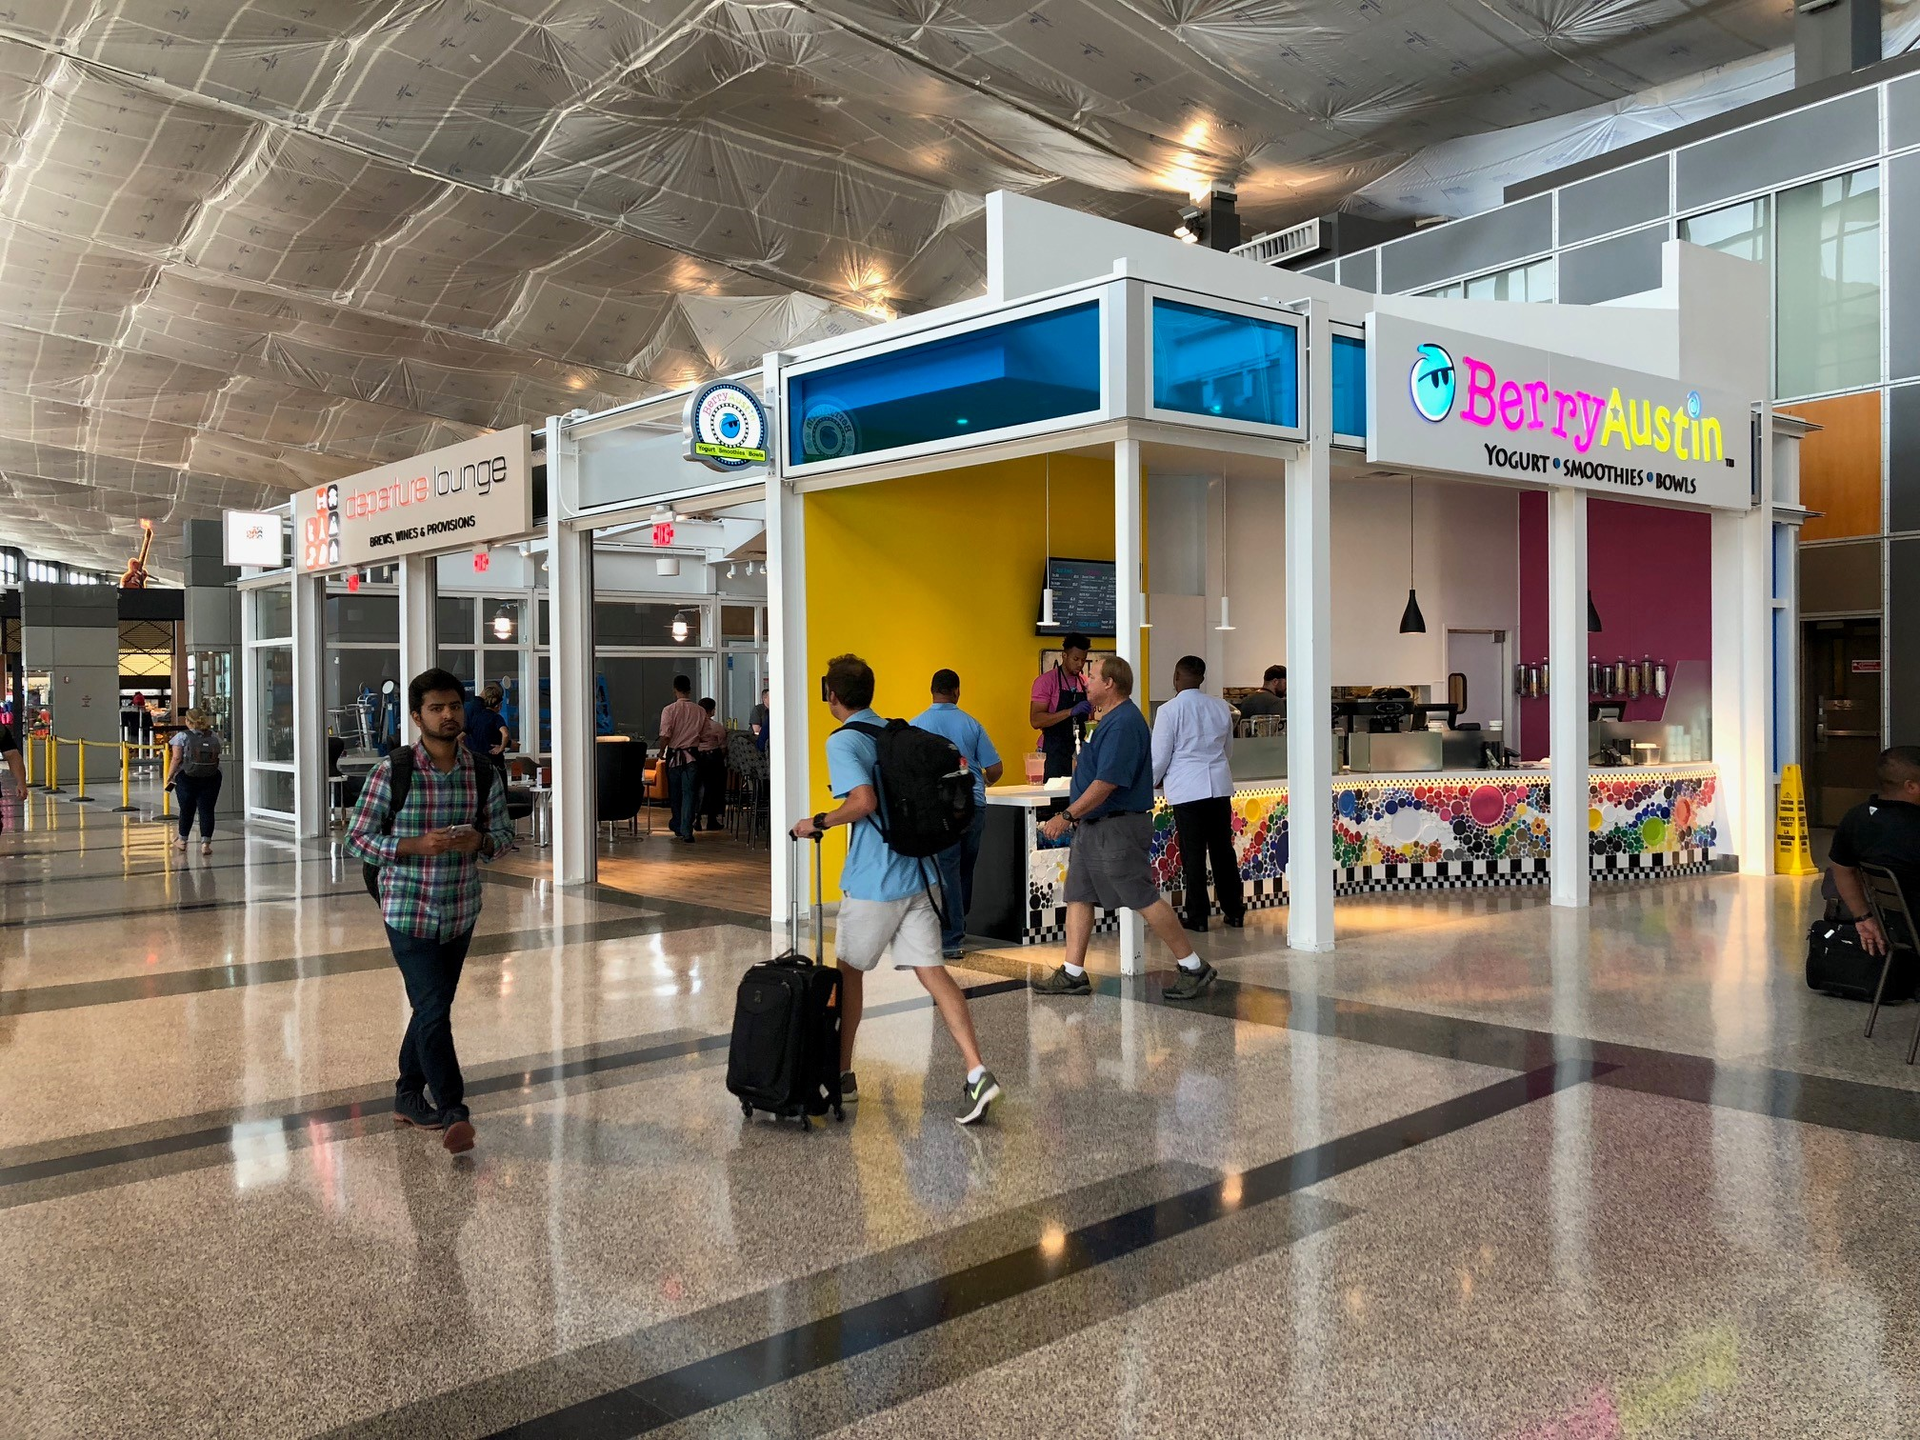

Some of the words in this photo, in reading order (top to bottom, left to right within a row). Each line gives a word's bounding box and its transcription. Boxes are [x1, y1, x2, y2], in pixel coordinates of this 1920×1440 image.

[1460, 356, 1723, 462] BerryAustin
[697, 444, 716, 453] Yogurt
[718, 447, 745, 456] Smoothies
[748, 450, 764, 458] Bowls
[1484, 443, 1550, 473] YOGURT
[1563, 459, 1644, 486] SMOOTHIES
[1655, 472, 1697, 494] BOWLS
[345, 476, 430, 521] departure
[433, 455, 508, 497] lounge
[369, 532, 395, 548] BREWS,
[395, 527, 419, 542] WINES
[419, 526, 426, 537] &
[427, 515, 476, 536] PROVISIONS
